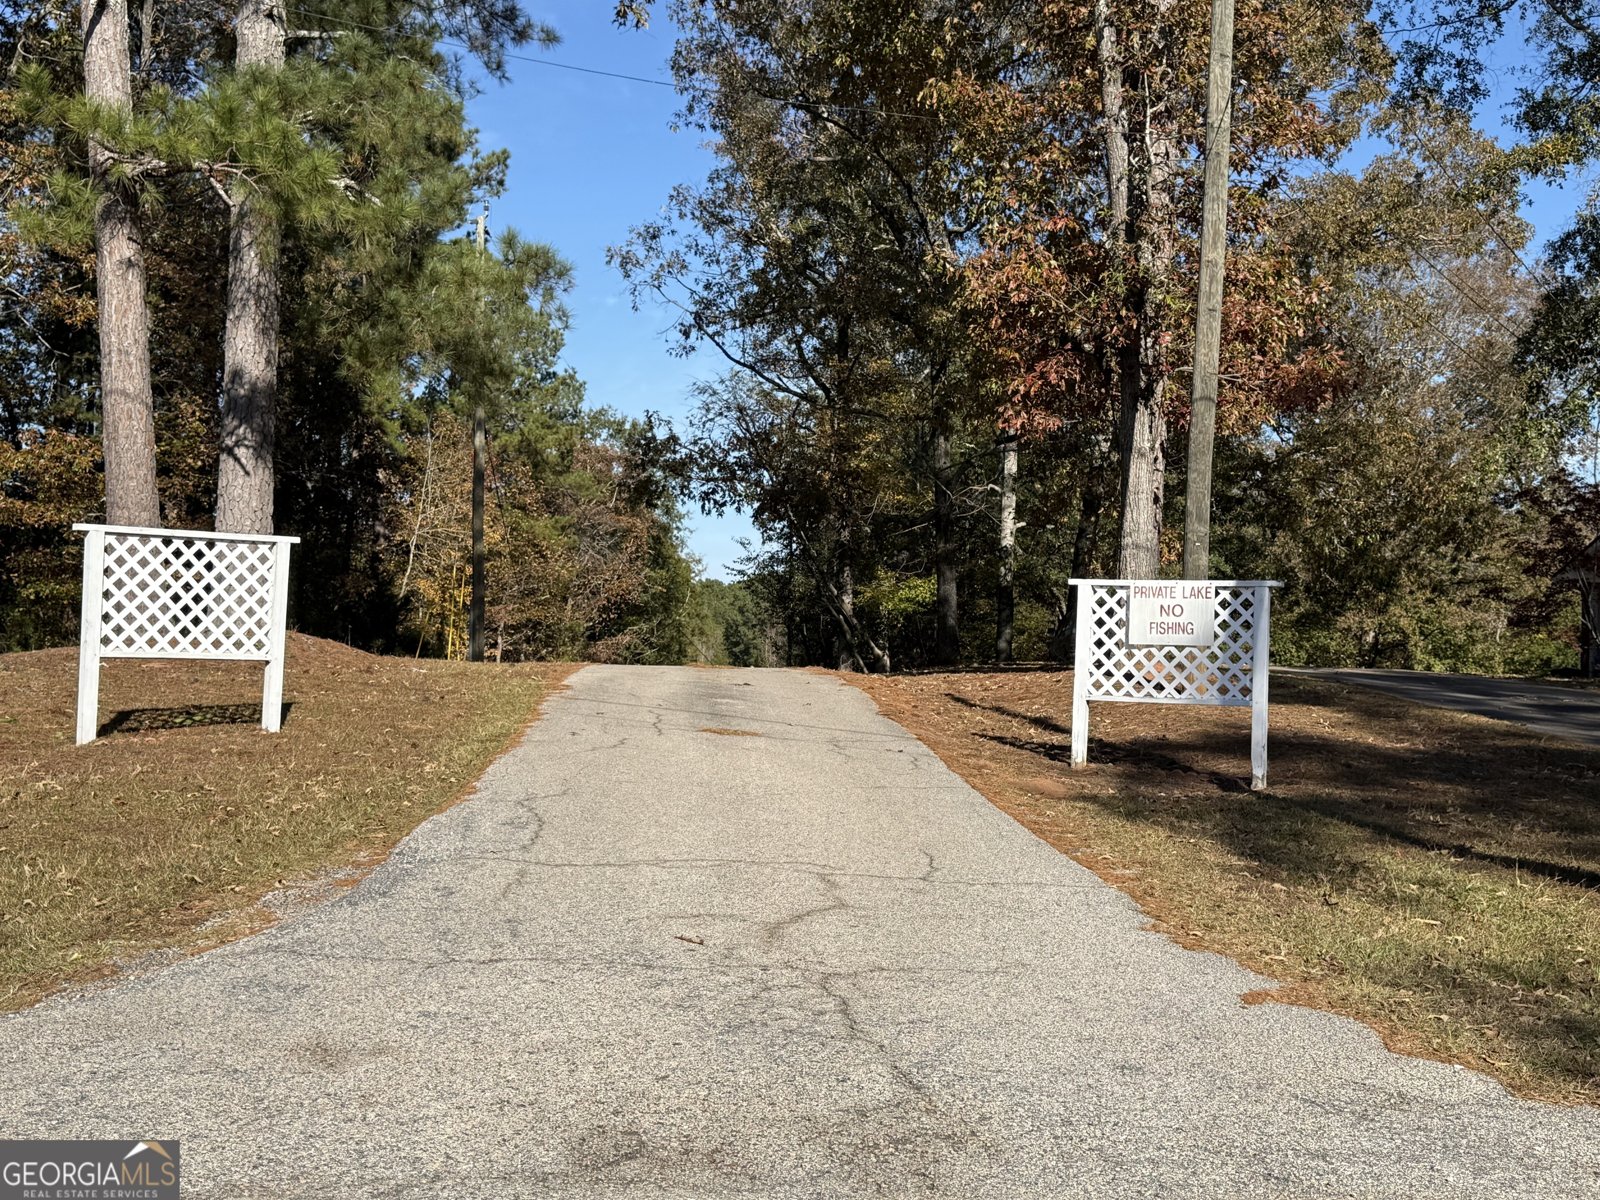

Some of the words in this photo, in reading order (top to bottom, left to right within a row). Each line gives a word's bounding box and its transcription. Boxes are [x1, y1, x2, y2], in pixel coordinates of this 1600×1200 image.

[1133, 586, 1177, 599] PRIVATE
[1182, 586, 1212, 599] LAKE
[1160, 604, 1184, 617] NO
[1149, 621, 1194, 635] FISHING
